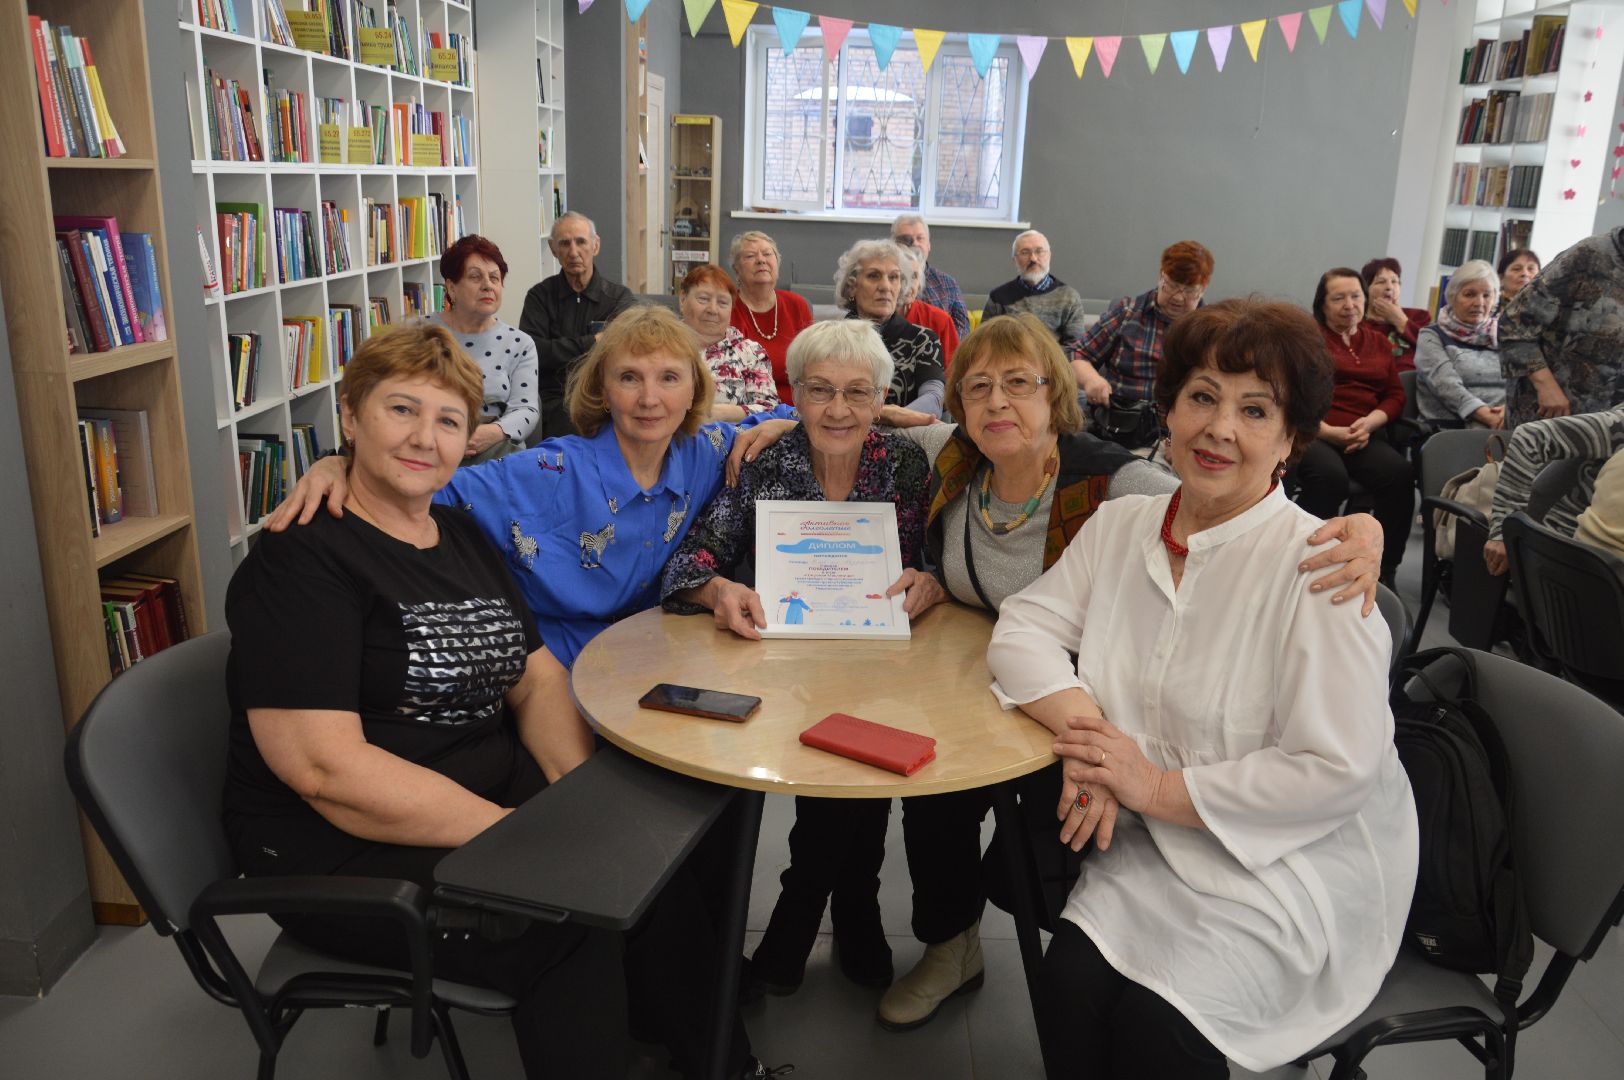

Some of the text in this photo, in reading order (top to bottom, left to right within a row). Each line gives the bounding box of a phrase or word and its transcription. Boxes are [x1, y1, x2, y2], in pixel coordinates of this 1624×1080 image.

[438, 52, 456, 60] 65.26
[103, 239, 129, 325] ЭКОНОМИЧЕСКАЯ ТЕОРИЯ
[114, 235, 139, 324] ЭКОНОМИЧЕСКАЯ ТЕОРИЯ
[808, 542, 856, 550] ДИПЛОМ
